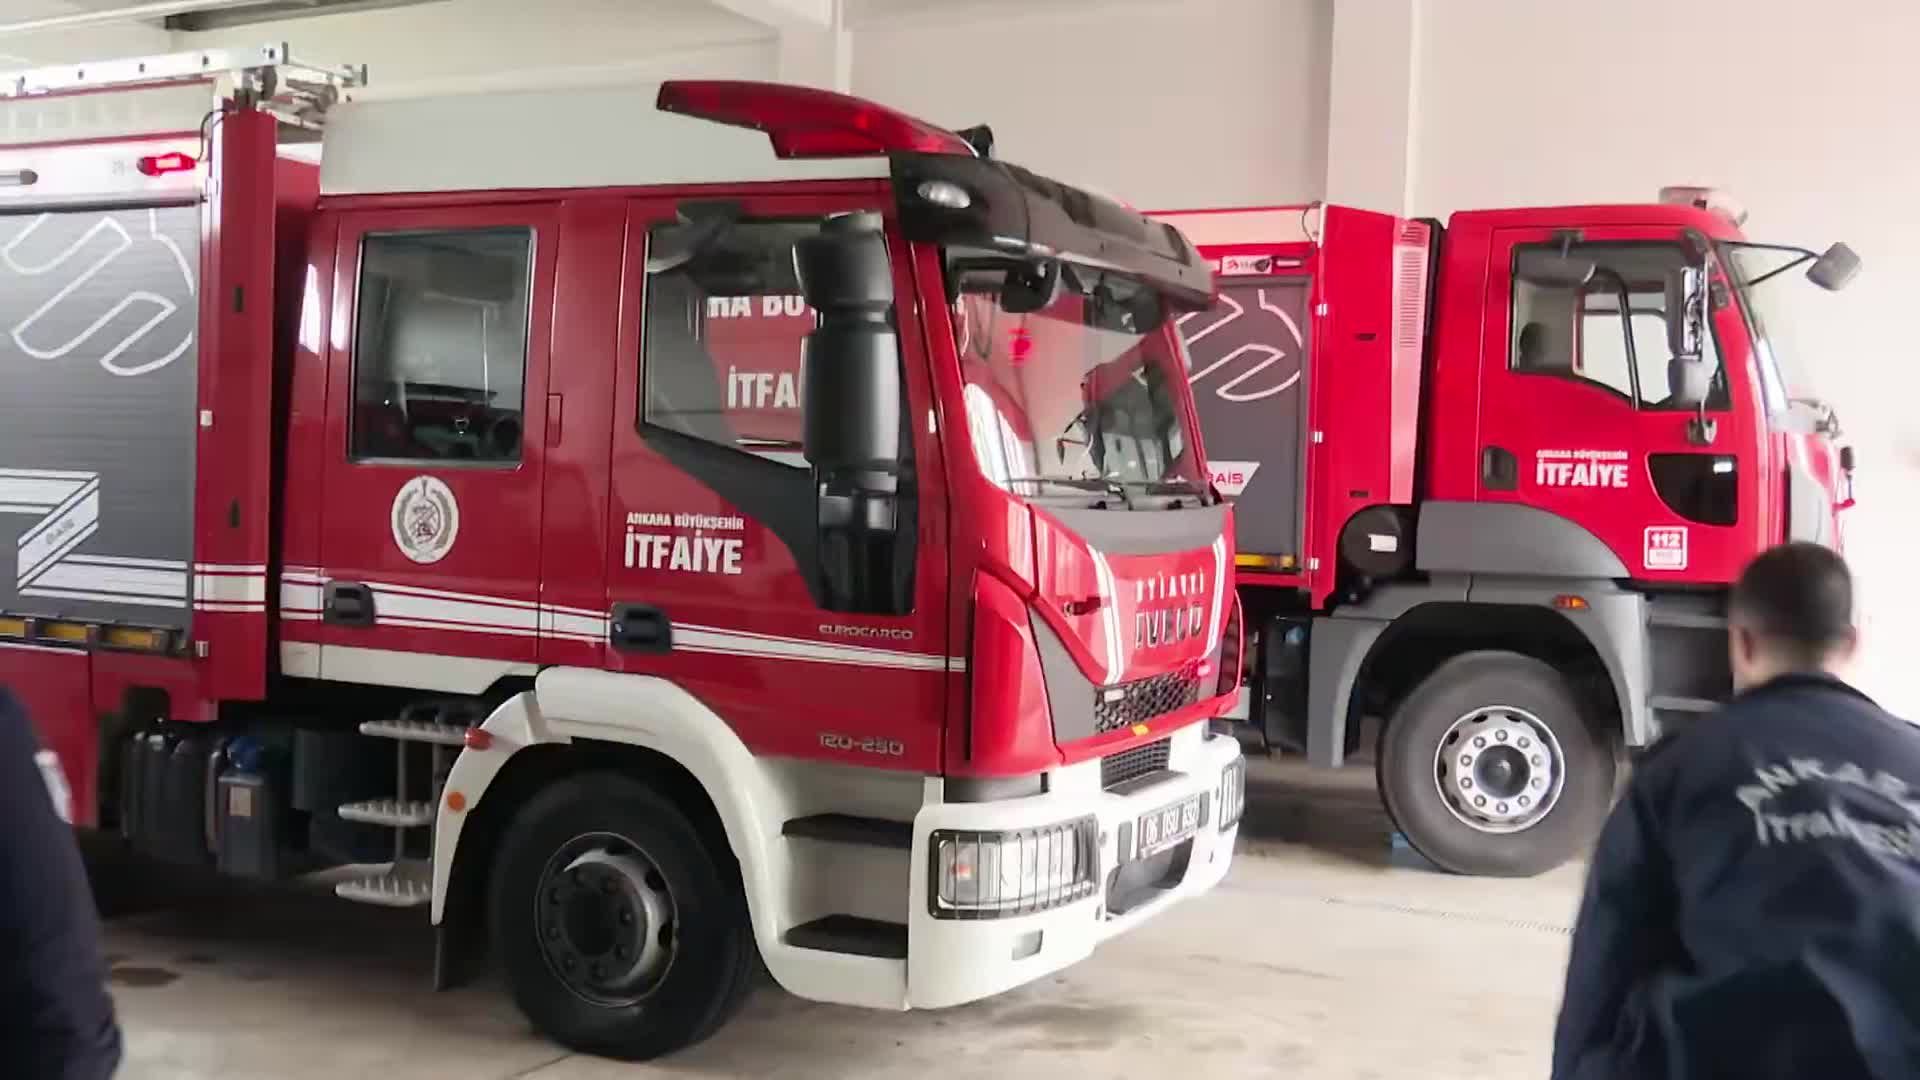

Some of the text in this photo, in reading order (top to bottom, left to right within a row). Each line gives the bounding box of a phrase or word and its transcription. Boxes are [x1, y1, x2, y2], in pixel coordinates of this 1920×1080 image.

[1536, 458, 1628, 488] İTFAİYE
[626, 511, 744, 530] ANKARA BÜYÜKŞEHİR
[625, 525, 743, 574] İTFAİYE
[1651, 532, 1681, 548] 112
[819, 624, 913, 639] EUROCARGO
